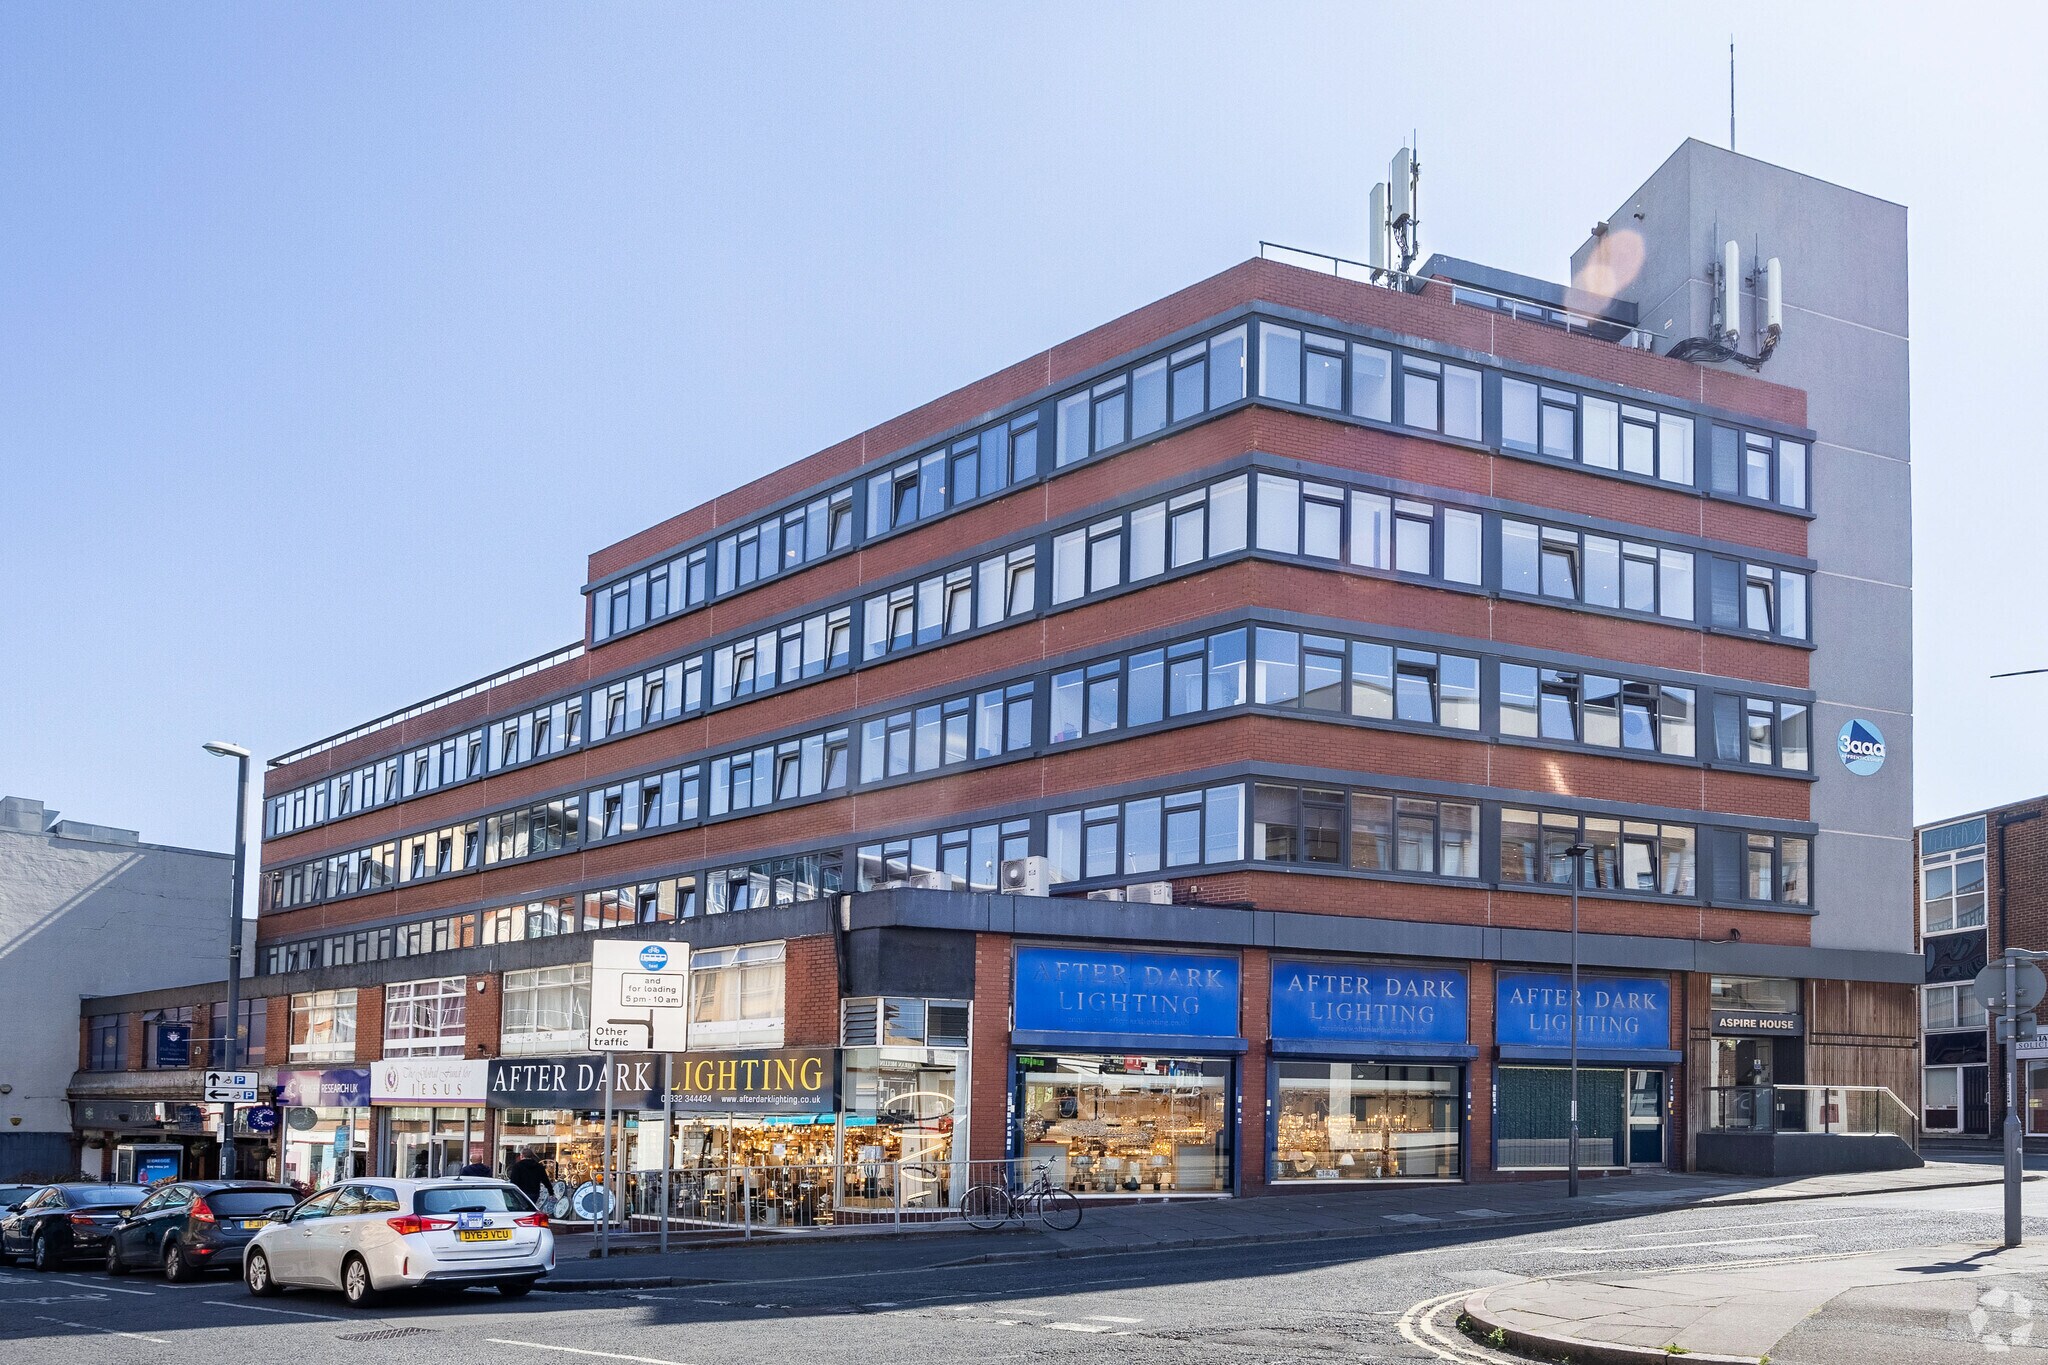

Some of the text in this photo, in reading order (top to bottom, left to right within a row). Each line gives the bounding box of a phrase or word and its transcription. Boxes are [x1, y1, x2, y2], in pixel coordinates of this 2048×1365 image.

[1840, 735, 1885, 757] 3aaa
[1033, 961, 1224, 988] AFTER DARK
[644, 985, 677, 994] loading
[1288, 974, 1455, 999] AFTER DARK
[1059, 991, 1200, 1015] LIGHTING
[1509, 988, 1657, 1010] AFTER DARK
[1311, 1002, 1435, 1024] LIGHTING
[596, 1027, 628, 1036] Other
[1529, 1013, 1640, 1034] LIGHTING
[1719, 1018, 1794, 1029] ASPIRE HOUSE
[594, 1037, 629, 1046] traffic
[492, 1065, 566, 1093] AFTER
[577, 1062, 652, 1092] DARK
[321, 1083, 349, 1094] RESEARCH
[350, 1083, 358, 1093] UK
[412, 1083, 462, 1097] JESUS
[660, 1094, 821, 1105] 0332 344424 www.afterdarklighting.co.uk
[464, 1230, 509, 1239] DY63 VCU
